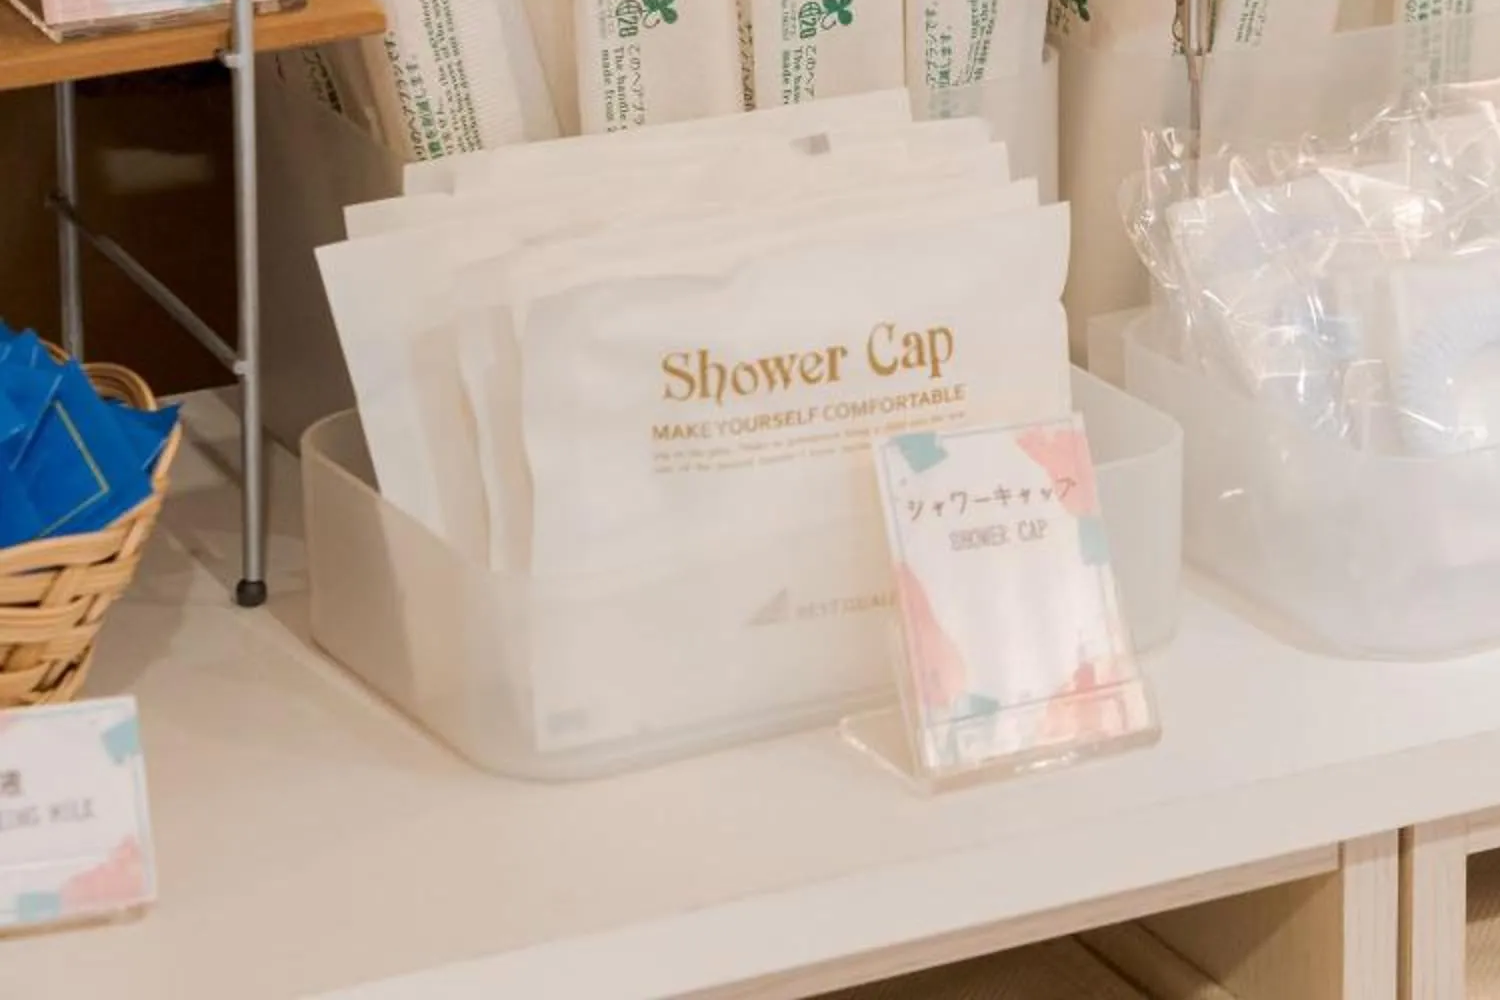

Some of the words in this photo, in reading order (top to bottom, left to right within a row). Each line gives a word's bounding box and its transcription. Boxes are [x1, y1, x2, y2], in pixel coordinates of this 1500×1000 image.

[661, 346, 848, 406] Shower
[866, 321, 955, 380] Cap
[651, 422, 713, 442] MAKE
[714, 406, 819, 437] YOURSELF
[822, 383, 968, 421] COMFORTABLE
[907, 476, 1078, 523] シャワーキャップ
[1017, 519, 1049, 542] CAP
